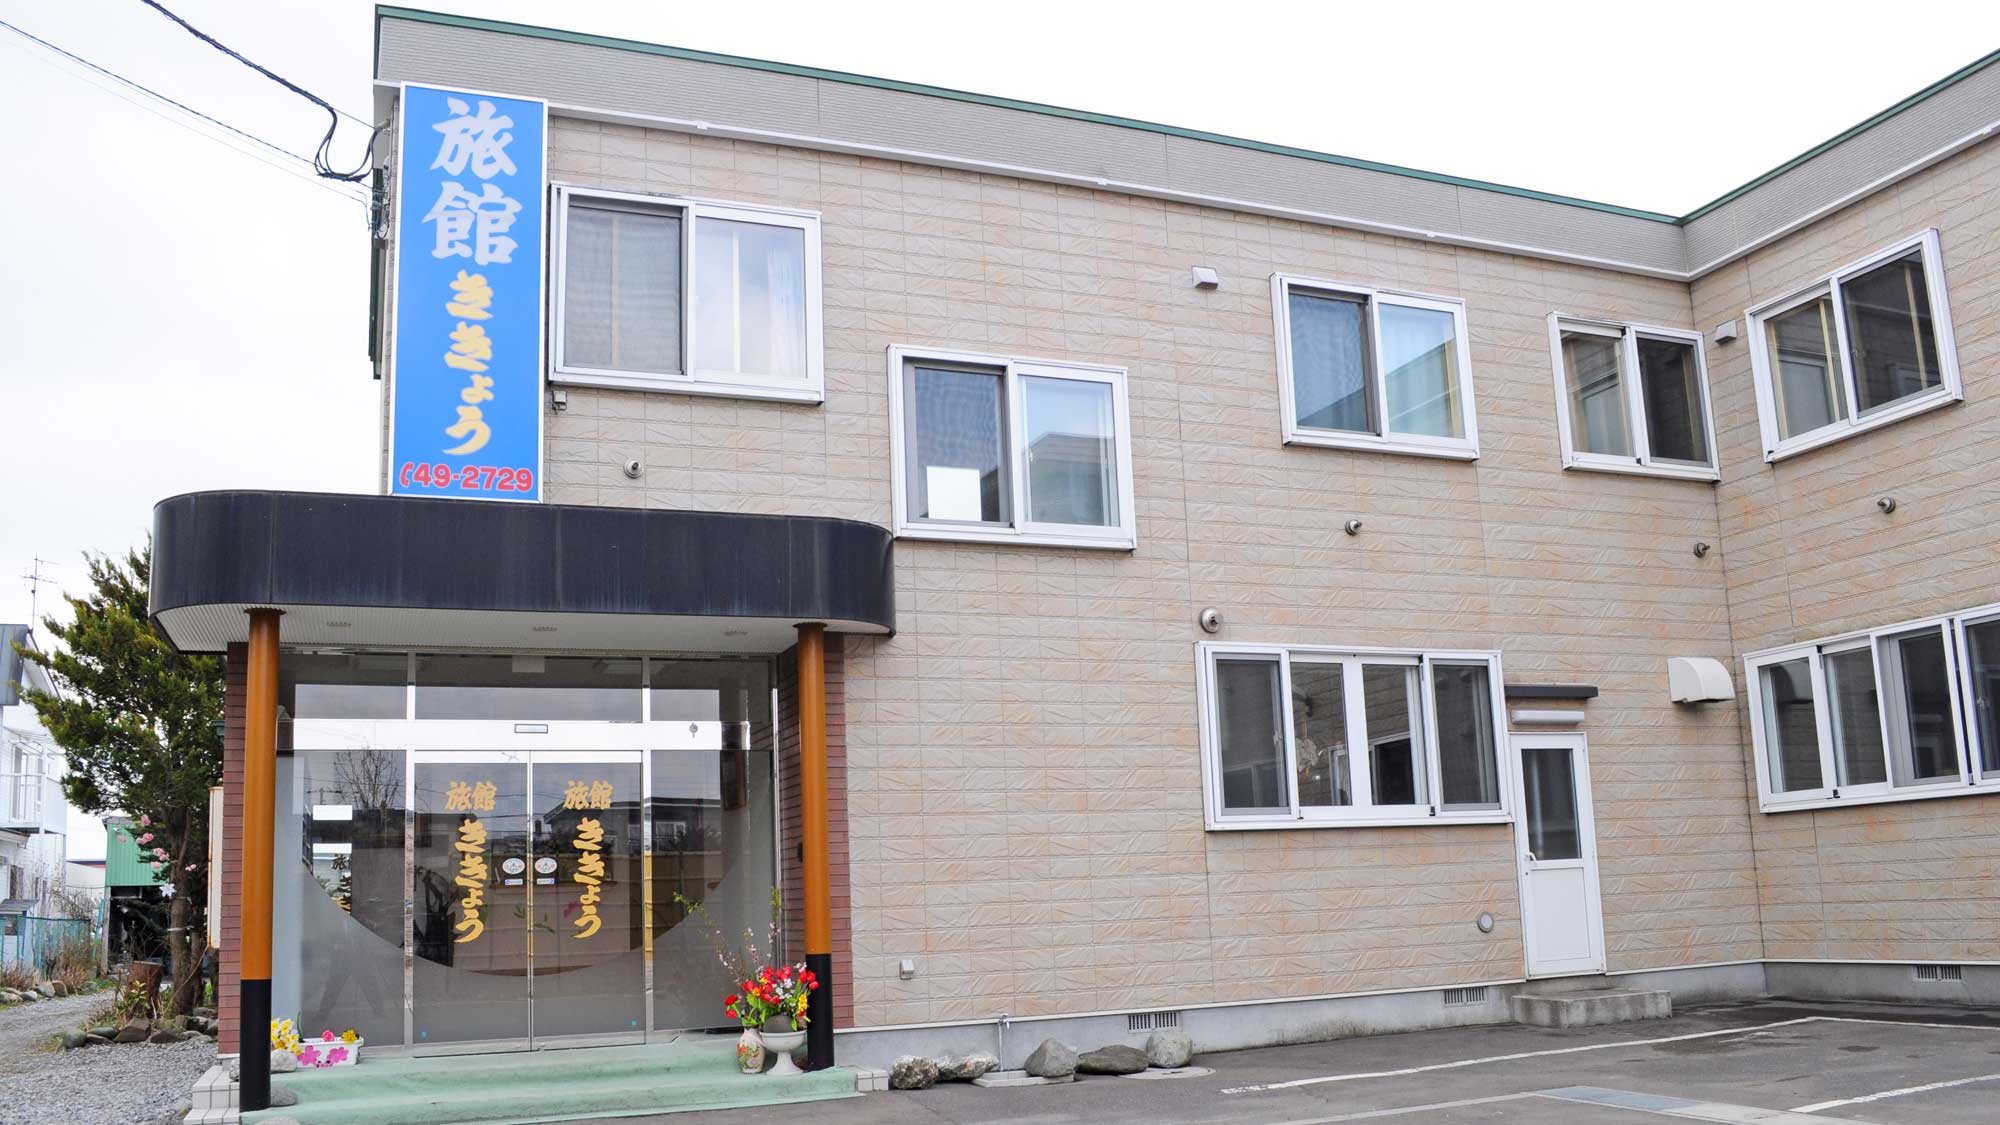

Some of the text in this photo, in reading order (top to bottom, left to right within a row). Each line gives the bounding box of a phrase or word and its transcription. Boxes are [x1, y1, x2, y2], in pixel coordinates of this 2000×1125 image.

[447, 782, 497, 811] 旅館
[564, 781, 613, 810] 旅館
[453, 818, 488, 943] ききょう
[572, 817, 605, 938] ききょう
